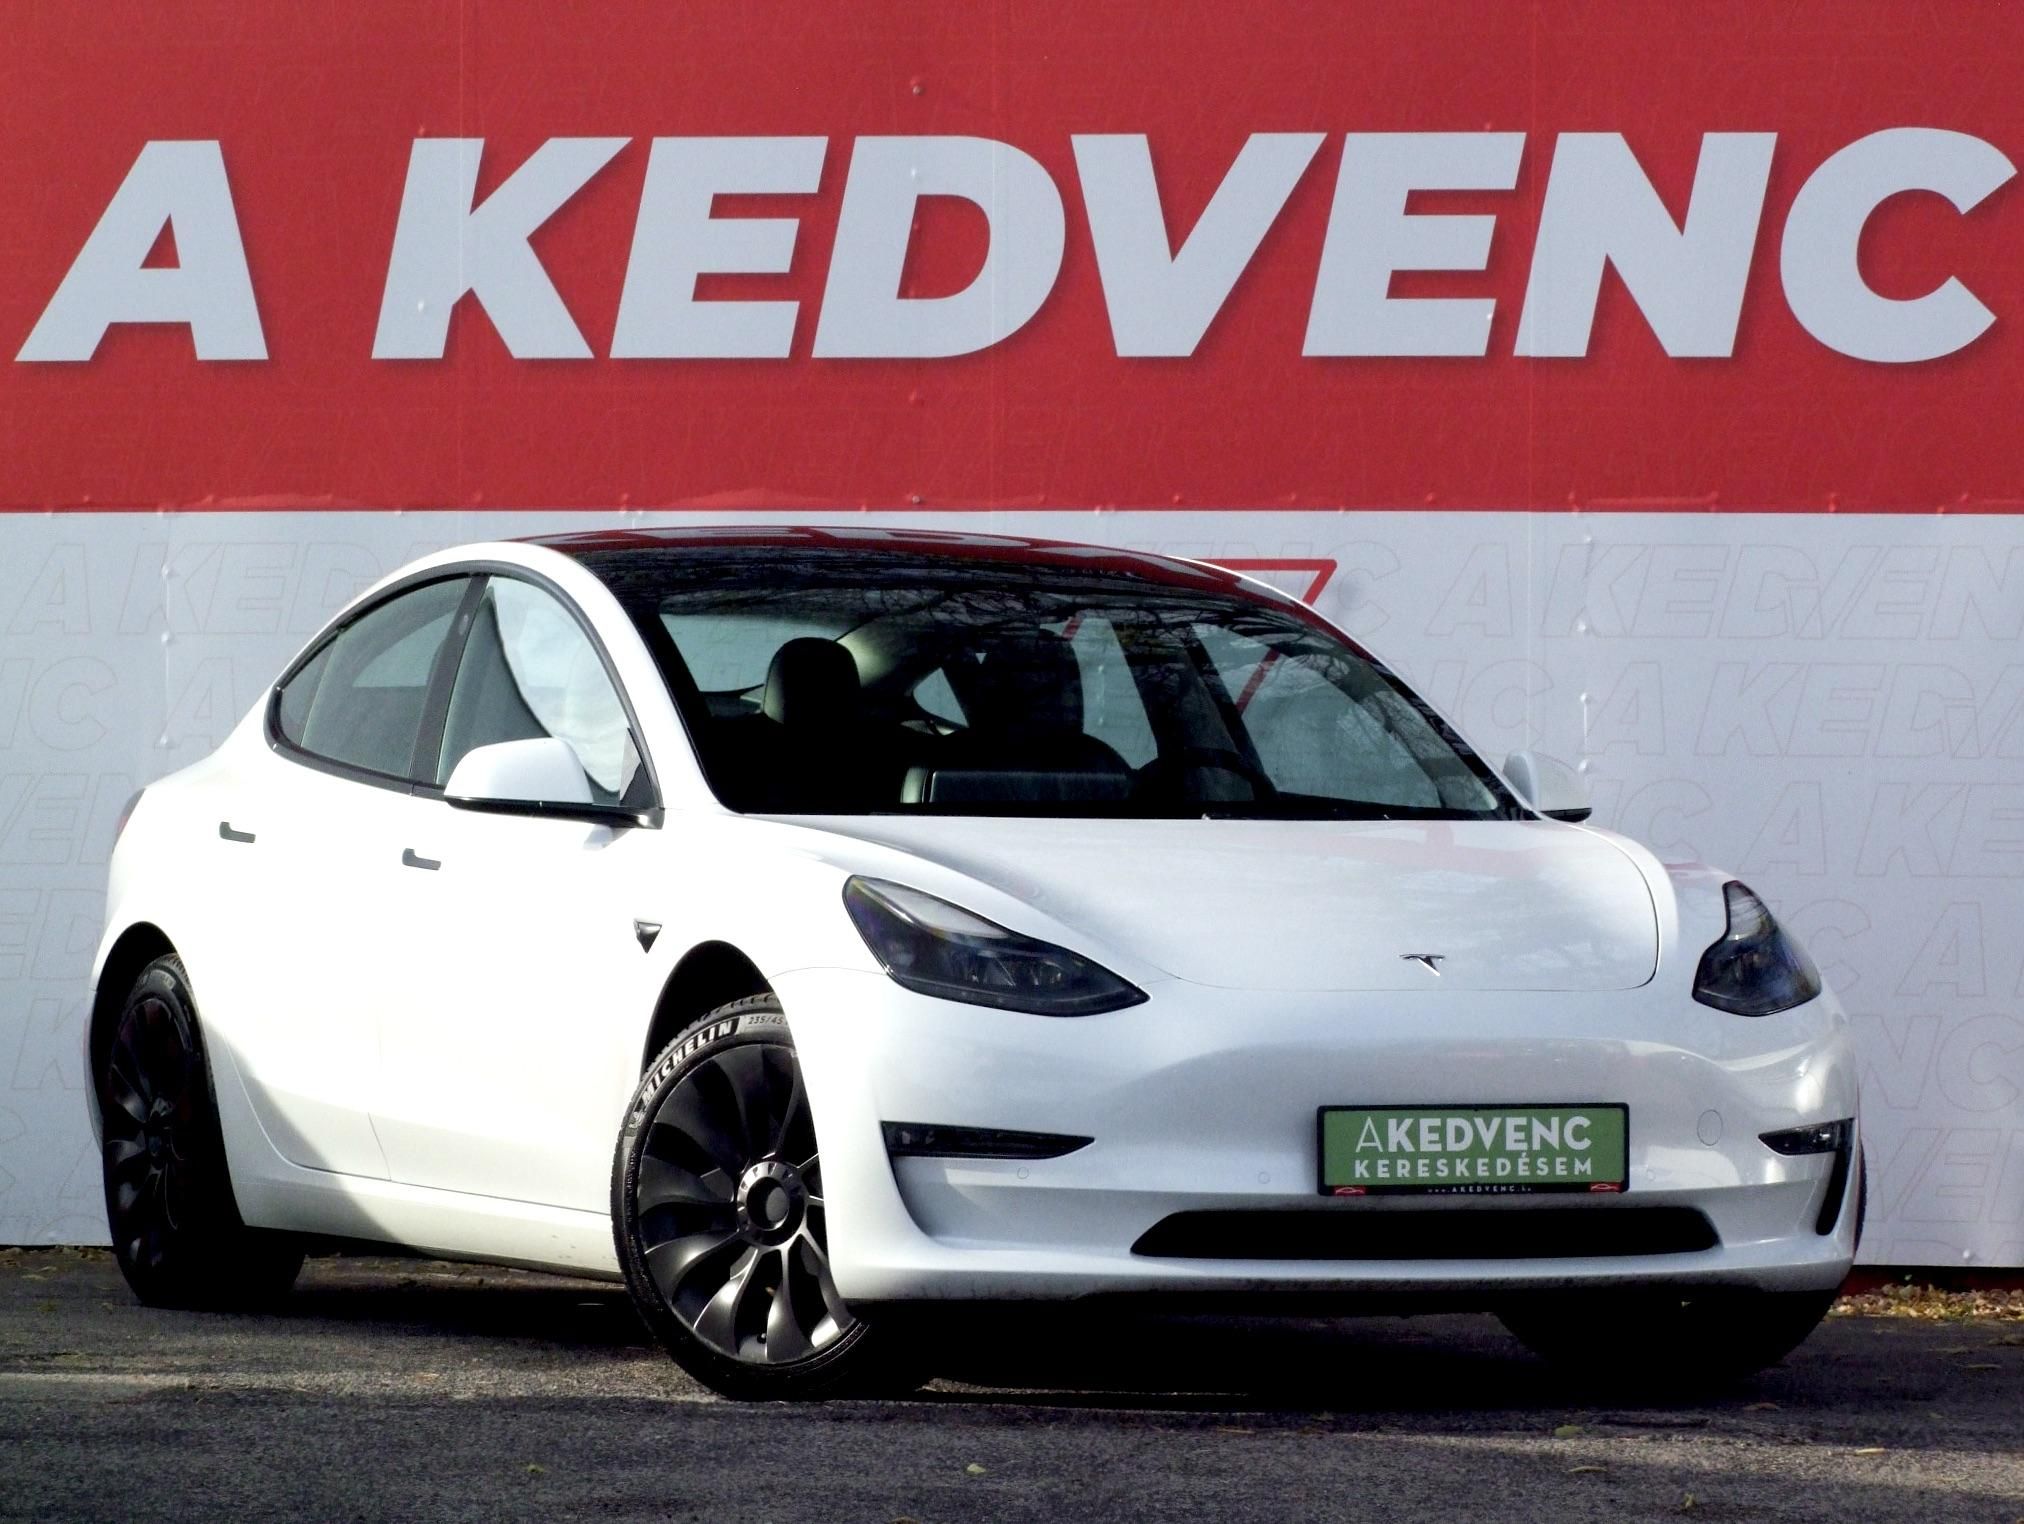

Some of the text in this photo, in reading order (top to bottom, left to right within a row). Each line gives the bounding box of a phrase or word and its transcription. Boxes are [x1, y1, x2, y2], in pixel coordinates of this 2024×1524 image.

[14, 127, 2018, 362] A KEDVENC
[641, 1020, 733, 1107] MICHELIN
[1354, 1152, 1592, 1178] KERESKEDÉSEM
